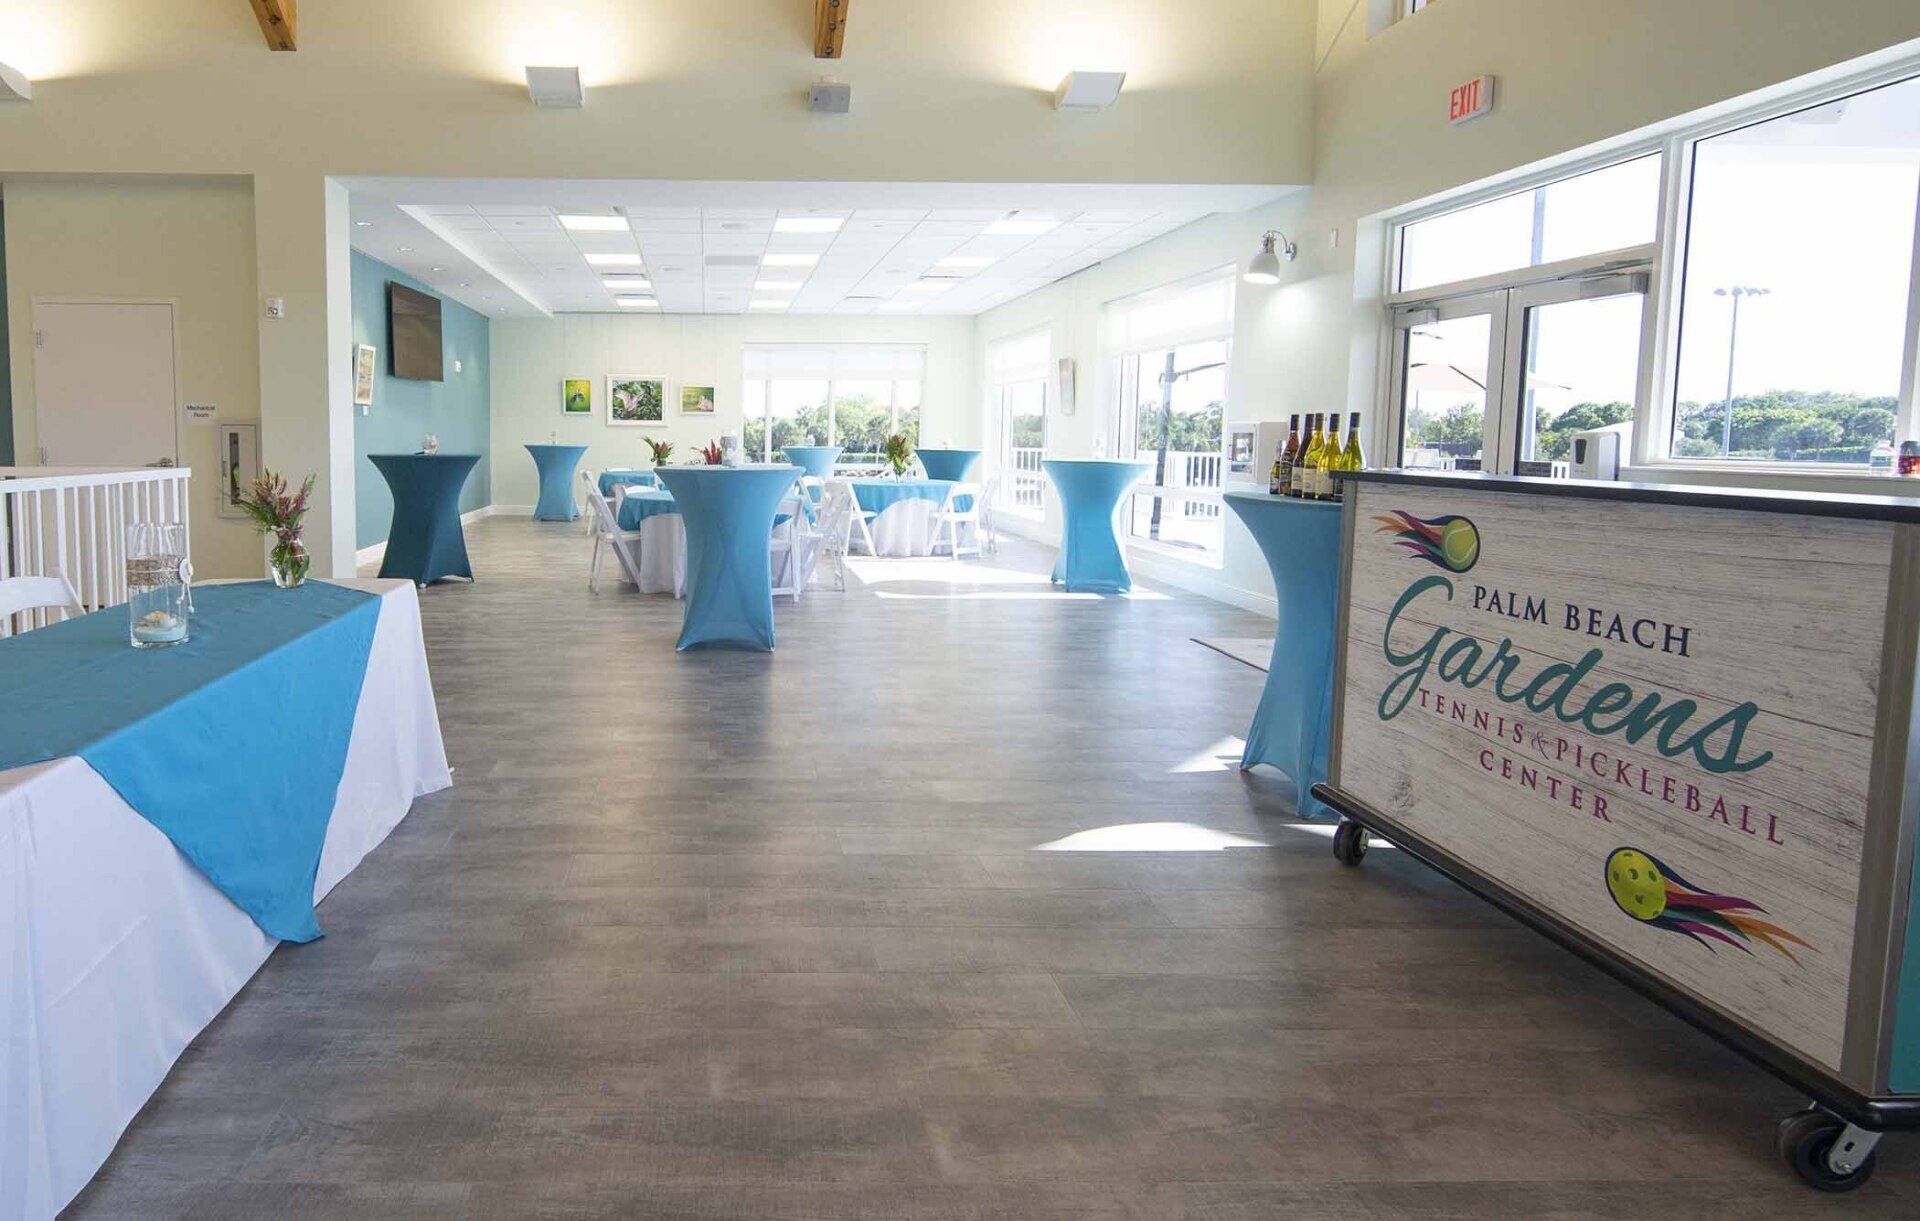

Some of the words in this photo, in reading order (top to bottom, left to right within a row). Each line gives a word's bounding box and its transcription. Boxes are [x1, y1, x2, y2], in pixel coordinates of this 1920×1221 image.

[1450, 78, 1481, 121] EXIT
[1473, 584, 1550, 625] PALM
[1564, 603, 1692, 658] BEACH
[1378, 575, 1773, 774] Gardens
[1419, 688, 1524, 744] TENNIS
[1531, 731, 1549, 759] &
[1556, 738, 1785, 846] PICKLEBALL
[1479, 750, 1612, 823] CENTER
